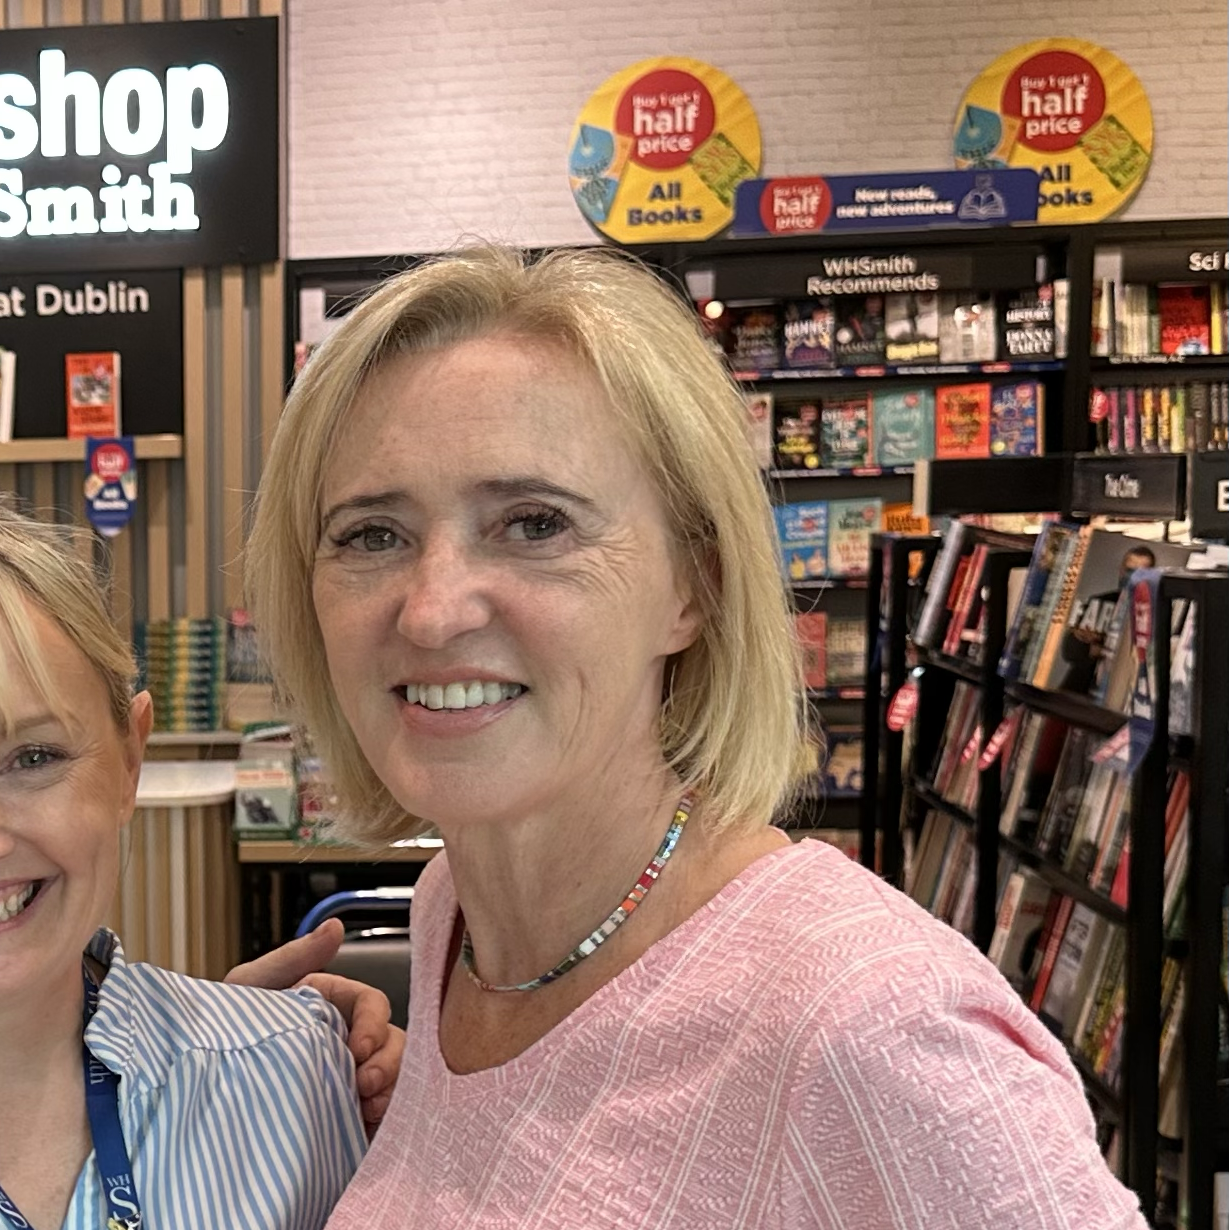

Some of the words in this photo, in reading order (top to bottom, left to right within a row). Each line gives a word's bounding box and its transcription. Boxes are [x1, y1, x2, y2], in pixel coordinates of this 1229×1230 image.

[1021, 86, 1089, 117] half
[632, 103, 700, 136] half
[1025, 117, 1083, 140] price
[637, 135, 694, 159] price
[1039, 165, 1072, 182] All
[648, 182, 682, 201] All
[855, 188, 887, 203] New
[890, 185, 938, 202] reads,
[1038, 189, 1094, 207] ooks
[627, 206, 704, 226] Books
[772, 193, 821, 217] half
[836, 206, 868, 219] new
[870, 201, 956, 218] adventures
[775, 216, 815, 231] price
[822, 253, 918, 278] WHSmith
[1189, 250, 1220, 272] Sci
[806, 271, 940, 297] Recommends
[35, 281, 150, 316] Dublin
